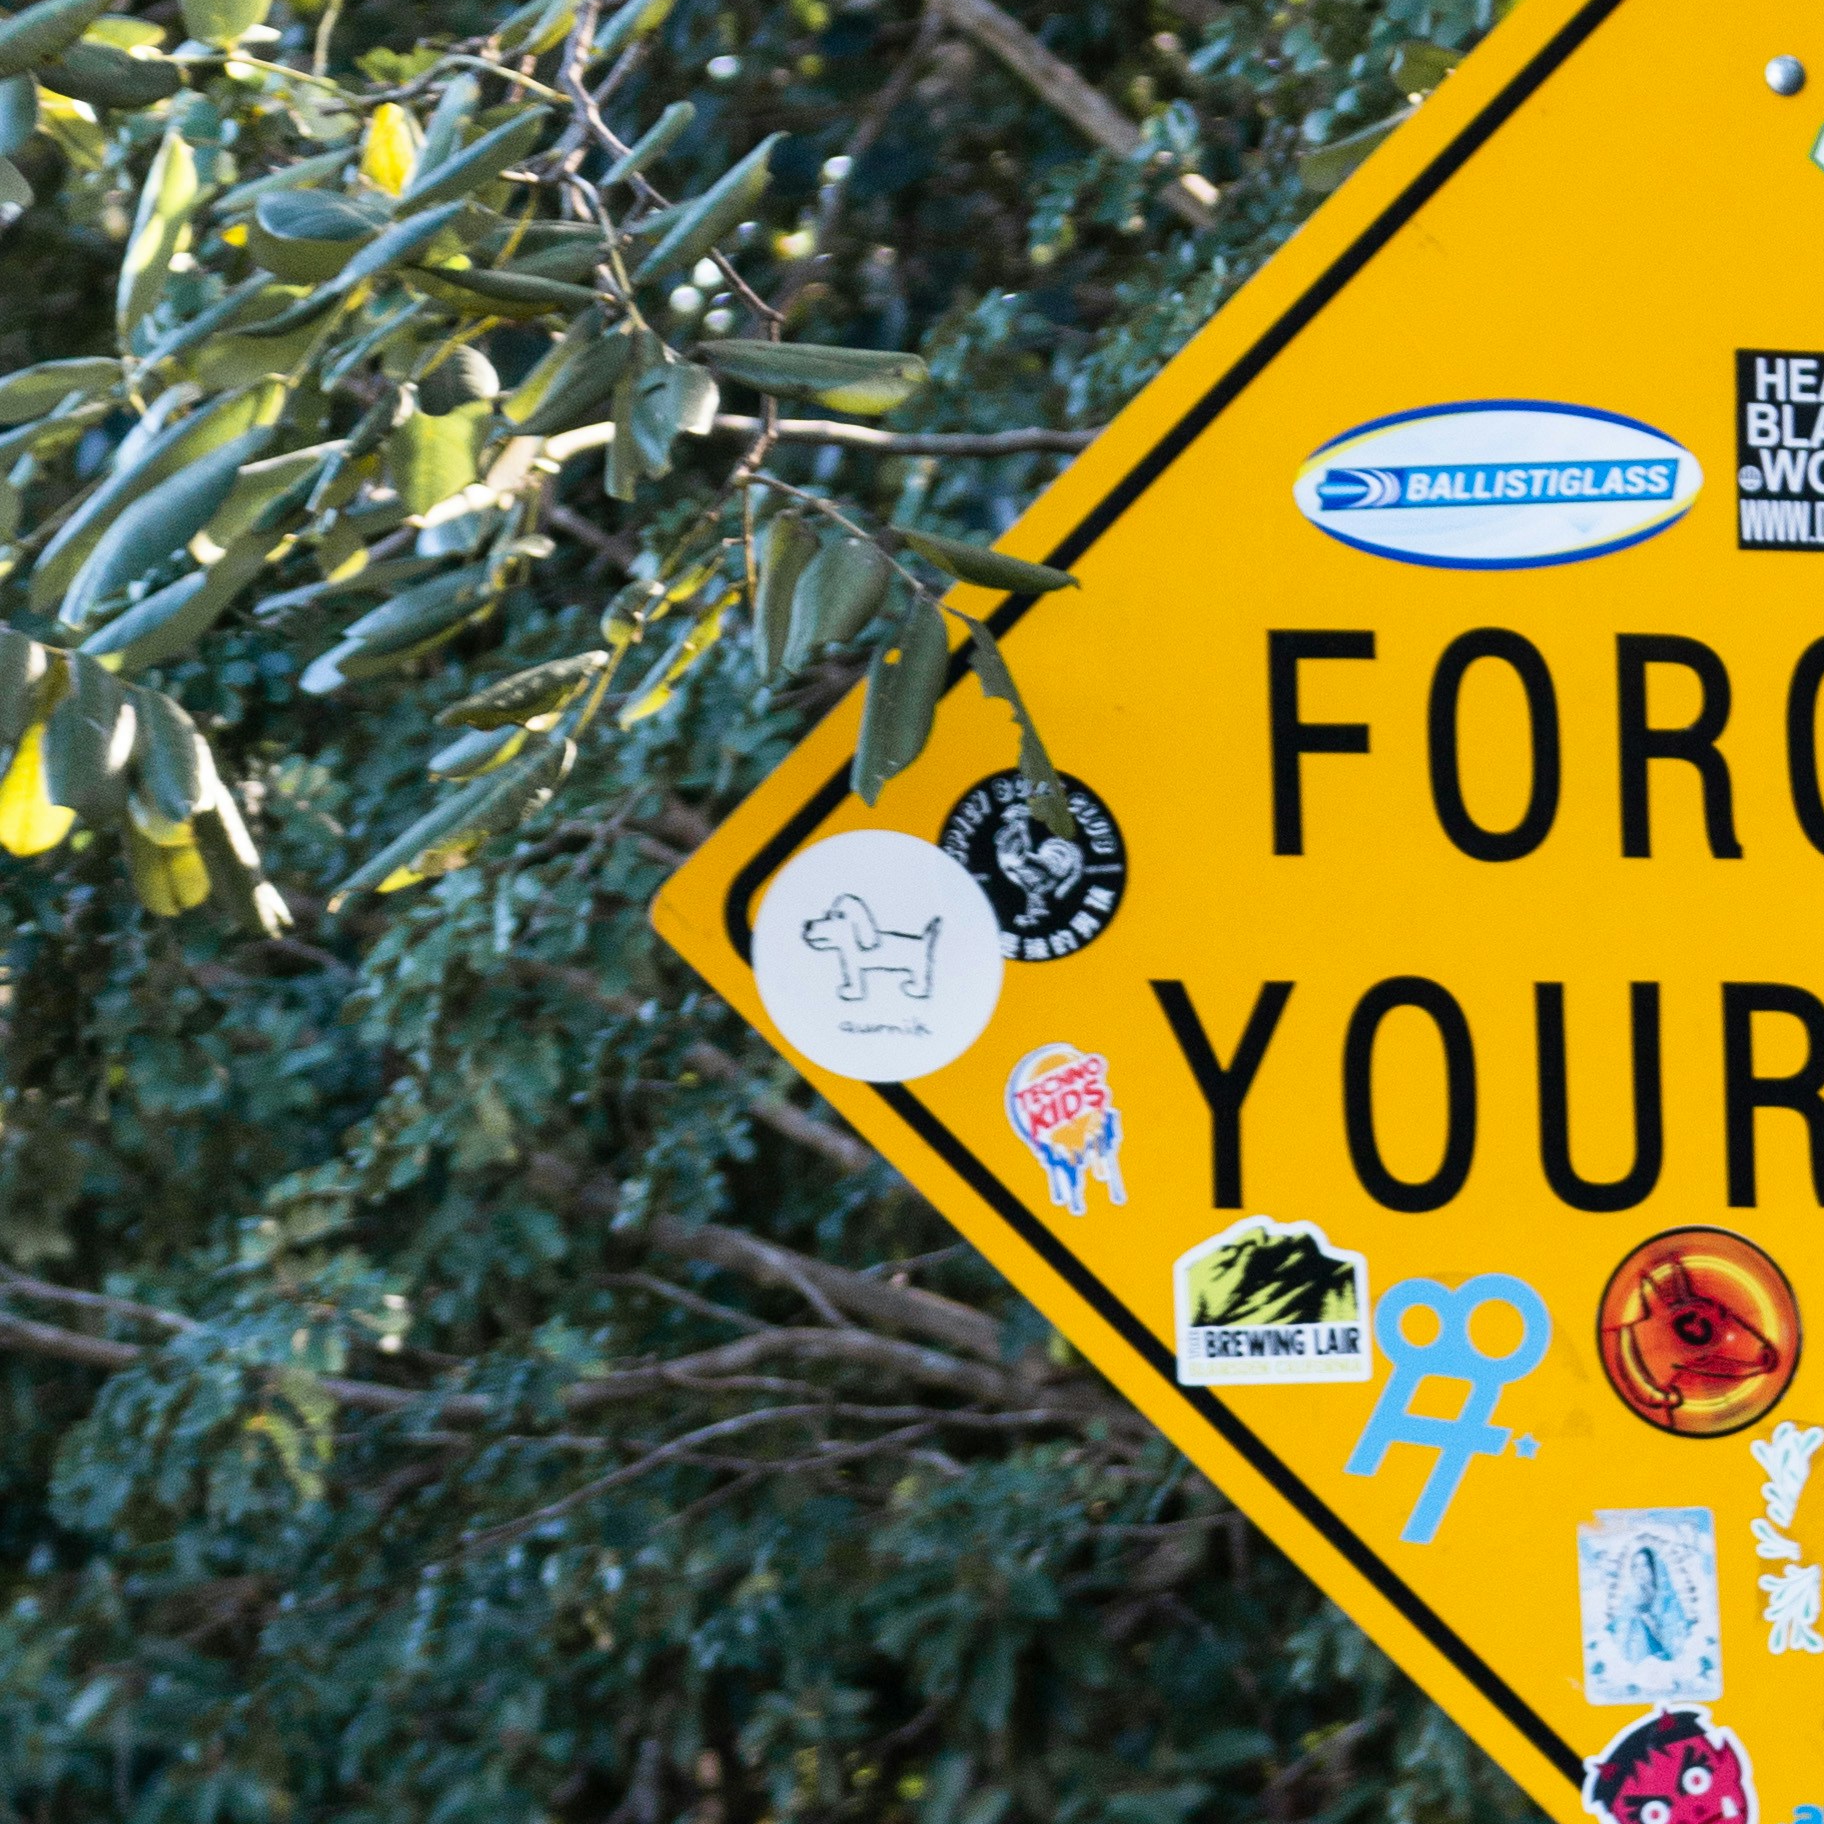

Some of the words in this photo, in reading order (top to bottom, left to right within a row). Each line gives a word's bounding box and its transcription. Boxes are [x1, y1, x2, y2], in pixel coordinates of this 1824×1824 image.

[1406, 465, 1670, 501] BALLISTIGLASS
[1030, 1079, 1106, 1139] KIDS
[1206, 1329, 1304, 1358] BREWING
[1314, 1326, 1361, 1355] LAIR
